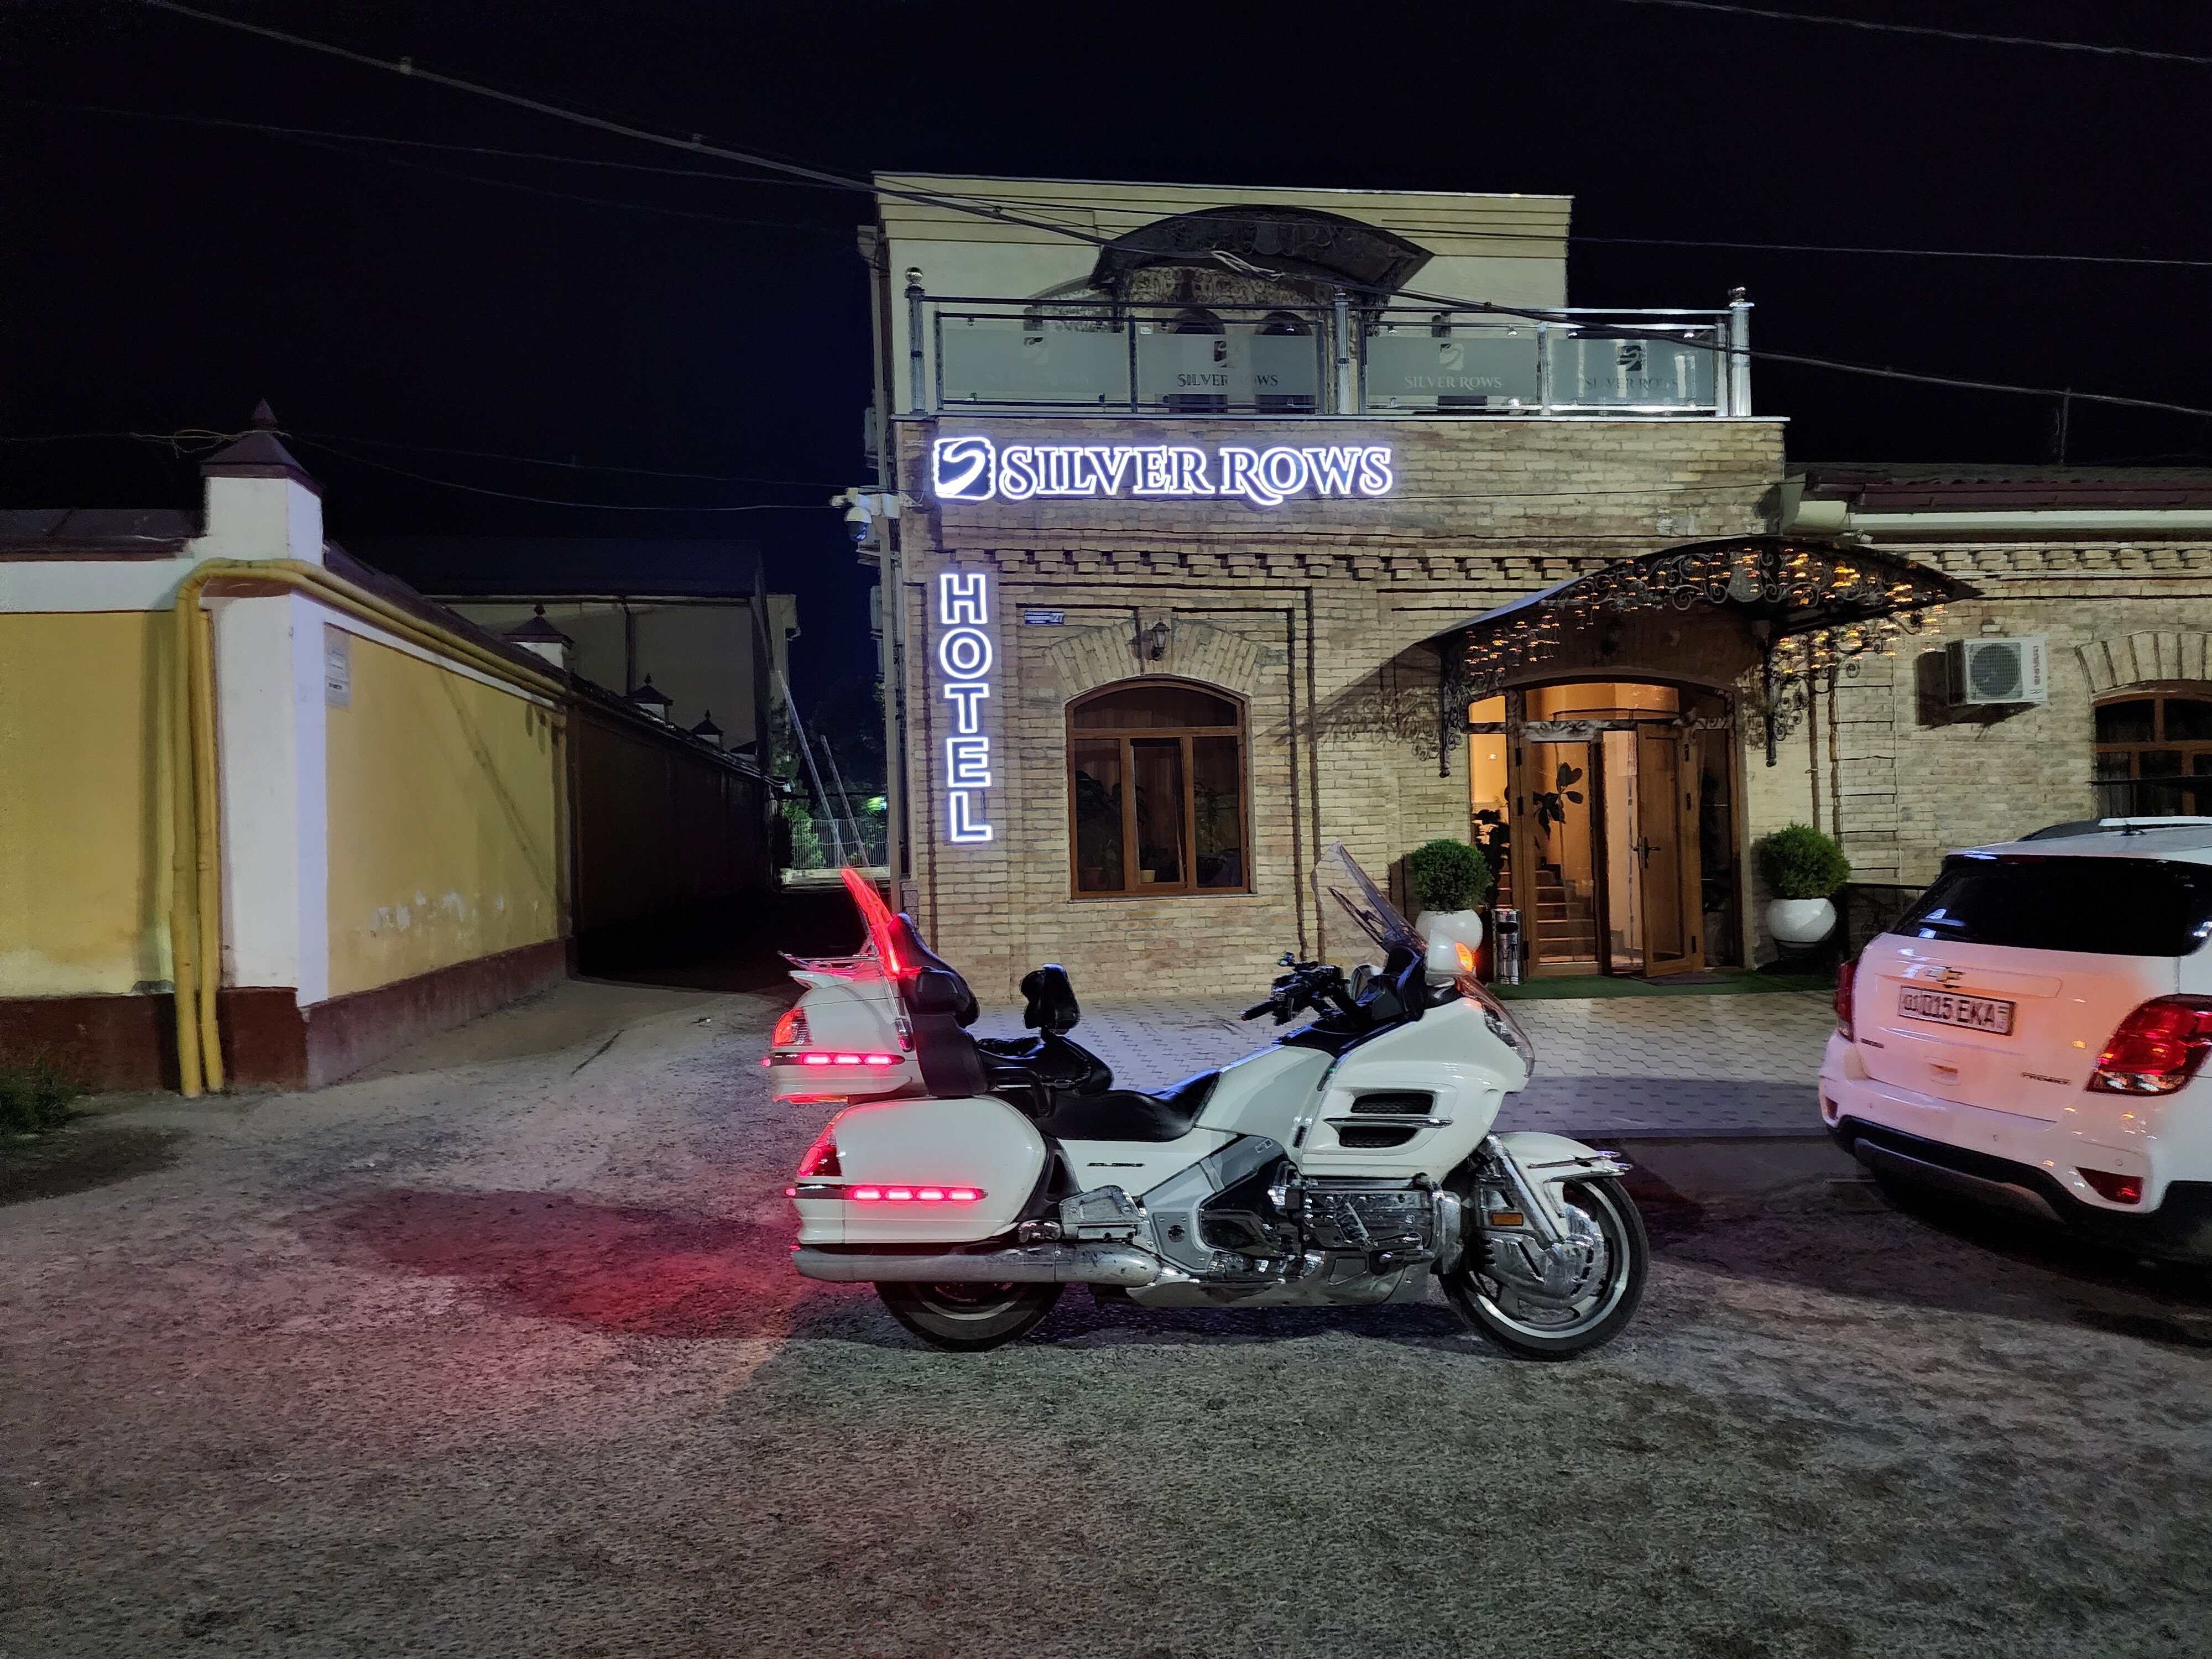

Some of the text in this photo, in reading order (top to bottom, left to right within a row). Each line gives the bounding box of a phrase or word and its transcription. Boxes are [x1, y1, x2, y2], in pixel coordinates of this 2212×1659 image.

[1404, 375, 1504, 390] SILVER ROWS
[1584, 377, 1634, 389] SIVER
[999, 445, 1394, 505] SILVER ROWS
[940, 573, 994, 842] HOTEL
[1957, 999, 1995, 1029] EKA
